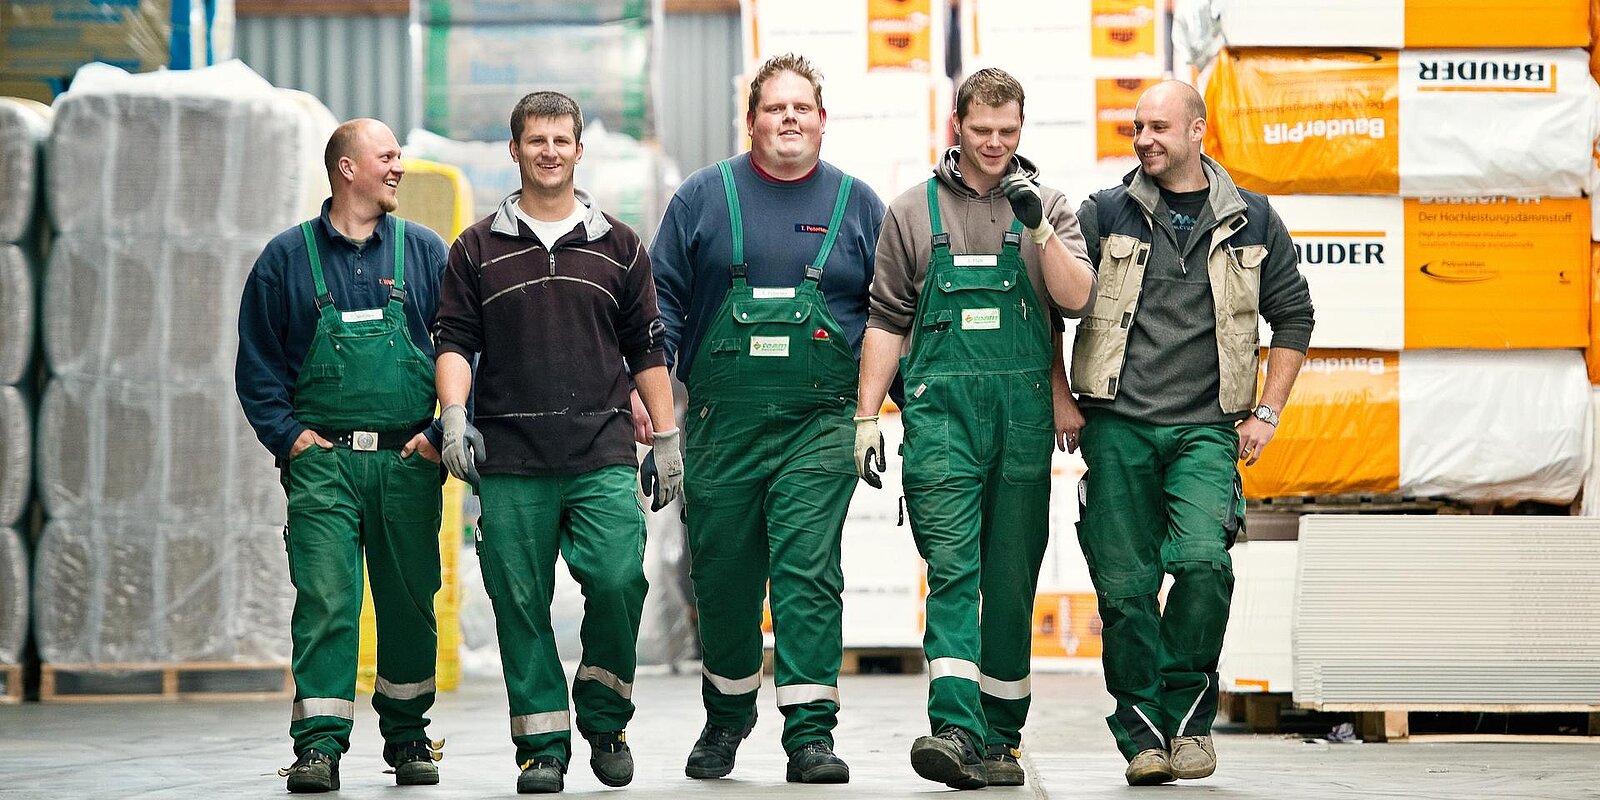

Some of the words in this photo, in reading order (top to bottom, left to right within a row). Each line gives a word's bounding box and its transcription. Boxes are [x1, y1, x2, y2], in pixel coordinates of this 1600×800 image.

[1419, 62, 1545, 81] BAUDER
[1263, 117, 1385, 144] BauderPIR
[1418, 212, 1437, 221] Der
